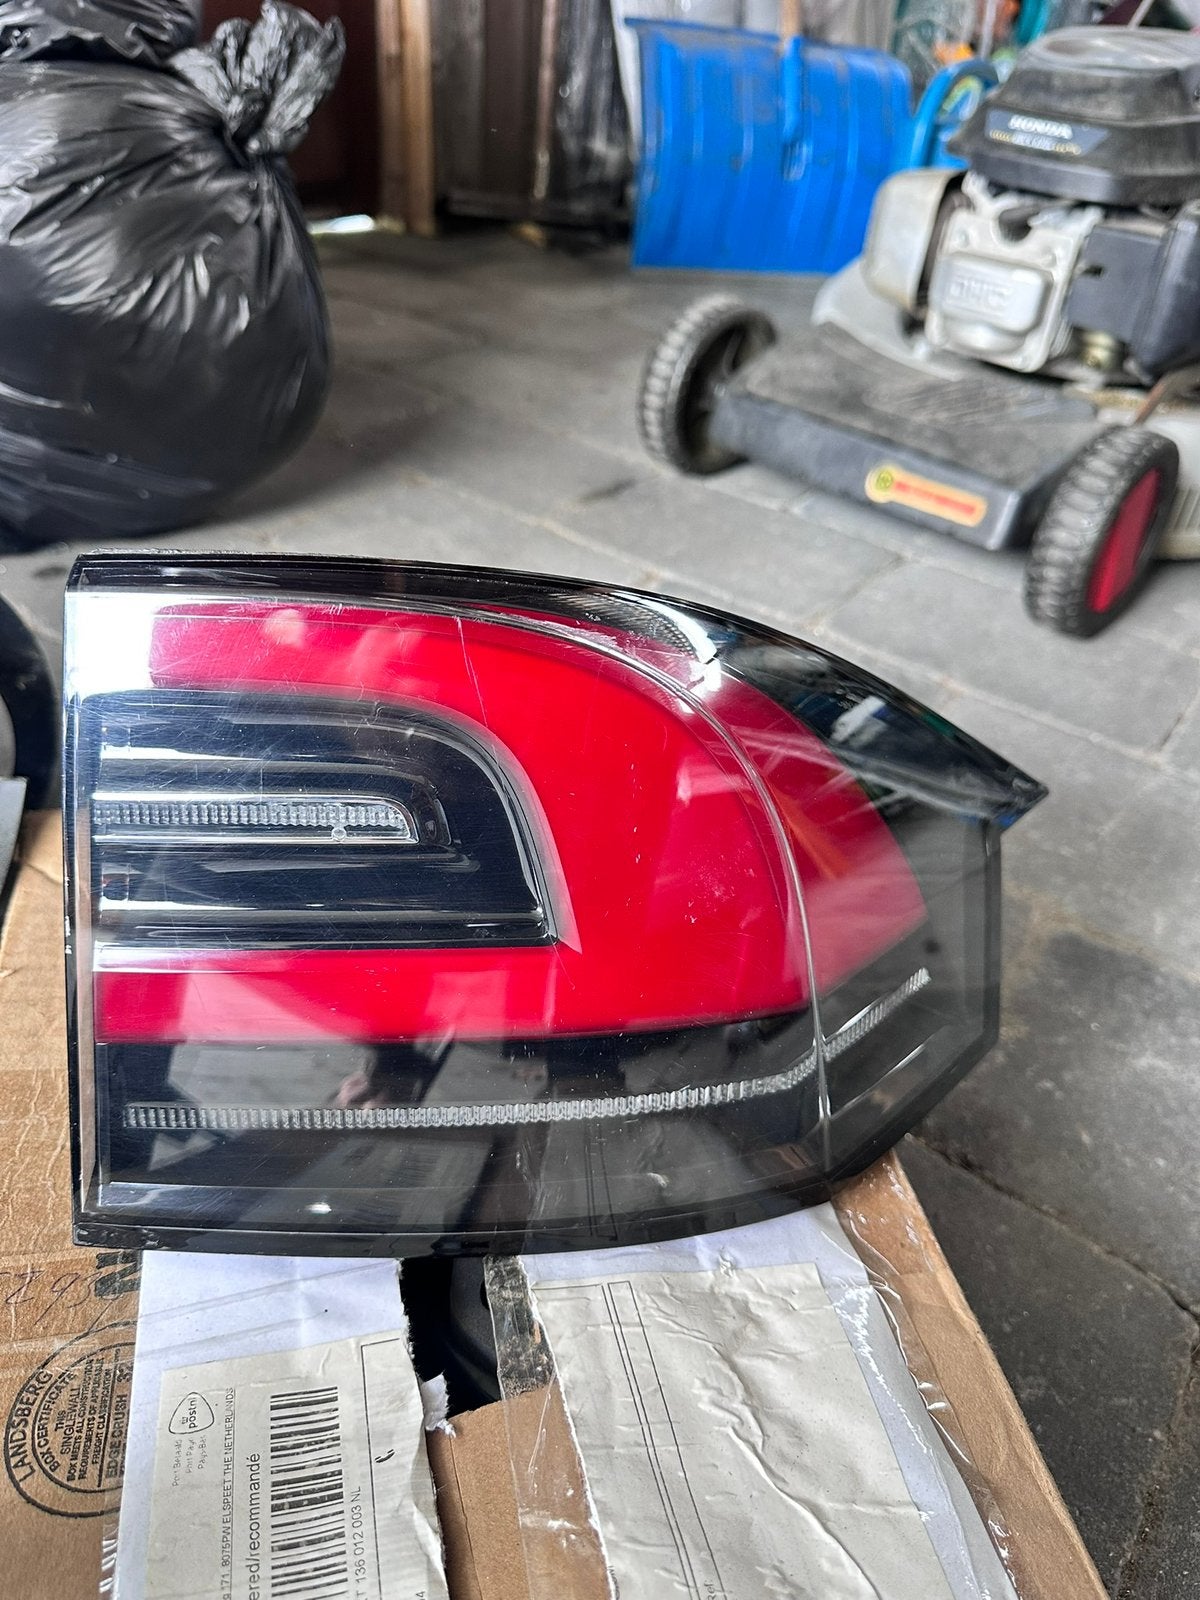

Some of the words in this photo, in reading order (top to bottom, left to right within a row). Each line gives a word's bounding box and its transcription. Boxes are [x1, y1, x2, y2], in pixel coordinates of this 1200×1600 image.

[77, 1358, 94, 1417] CONSTRUCTION
[96, 1368, 112, 1430] CLASSIFICATION
[10, 1370, 53, 1482] LANDSBERG
[36, 1370, 77, 1449] CERTIFICATE
[55, 1410, 67, 1431] THIS
[60, 1387, 80, 1455] SINGLEWALL
[76, 1417, 85, 1432] ALL
[111, 1393, 128, 1438] CRUSH
[224, 1387, 234, 1454] NETHERLANDS
[39, 1446, 61, 1473] BOX
[70, 1432, 82, 1461] MEETS
[77, 1416, 97, 1480] REQUIREMENTS
[87, 1402, 97, 1416] OF
[91, 1433, 104, 1465] FREIGHT
[106, 1437, 121, 1479] EDGE
[66, 1459, 78, 1481] BOX
[223, 1456, 233, 1476] THE
[222, 1480, 233, 1524] ELSPEET
[350, 1486, 361, 1503] NL
[350, 1504, 363, 1529] 003
[221, 1526, 232, 1568] 8075PW
[352, 1530, 364, 1556] 012
[353, 1558, 367, 1584] 136
